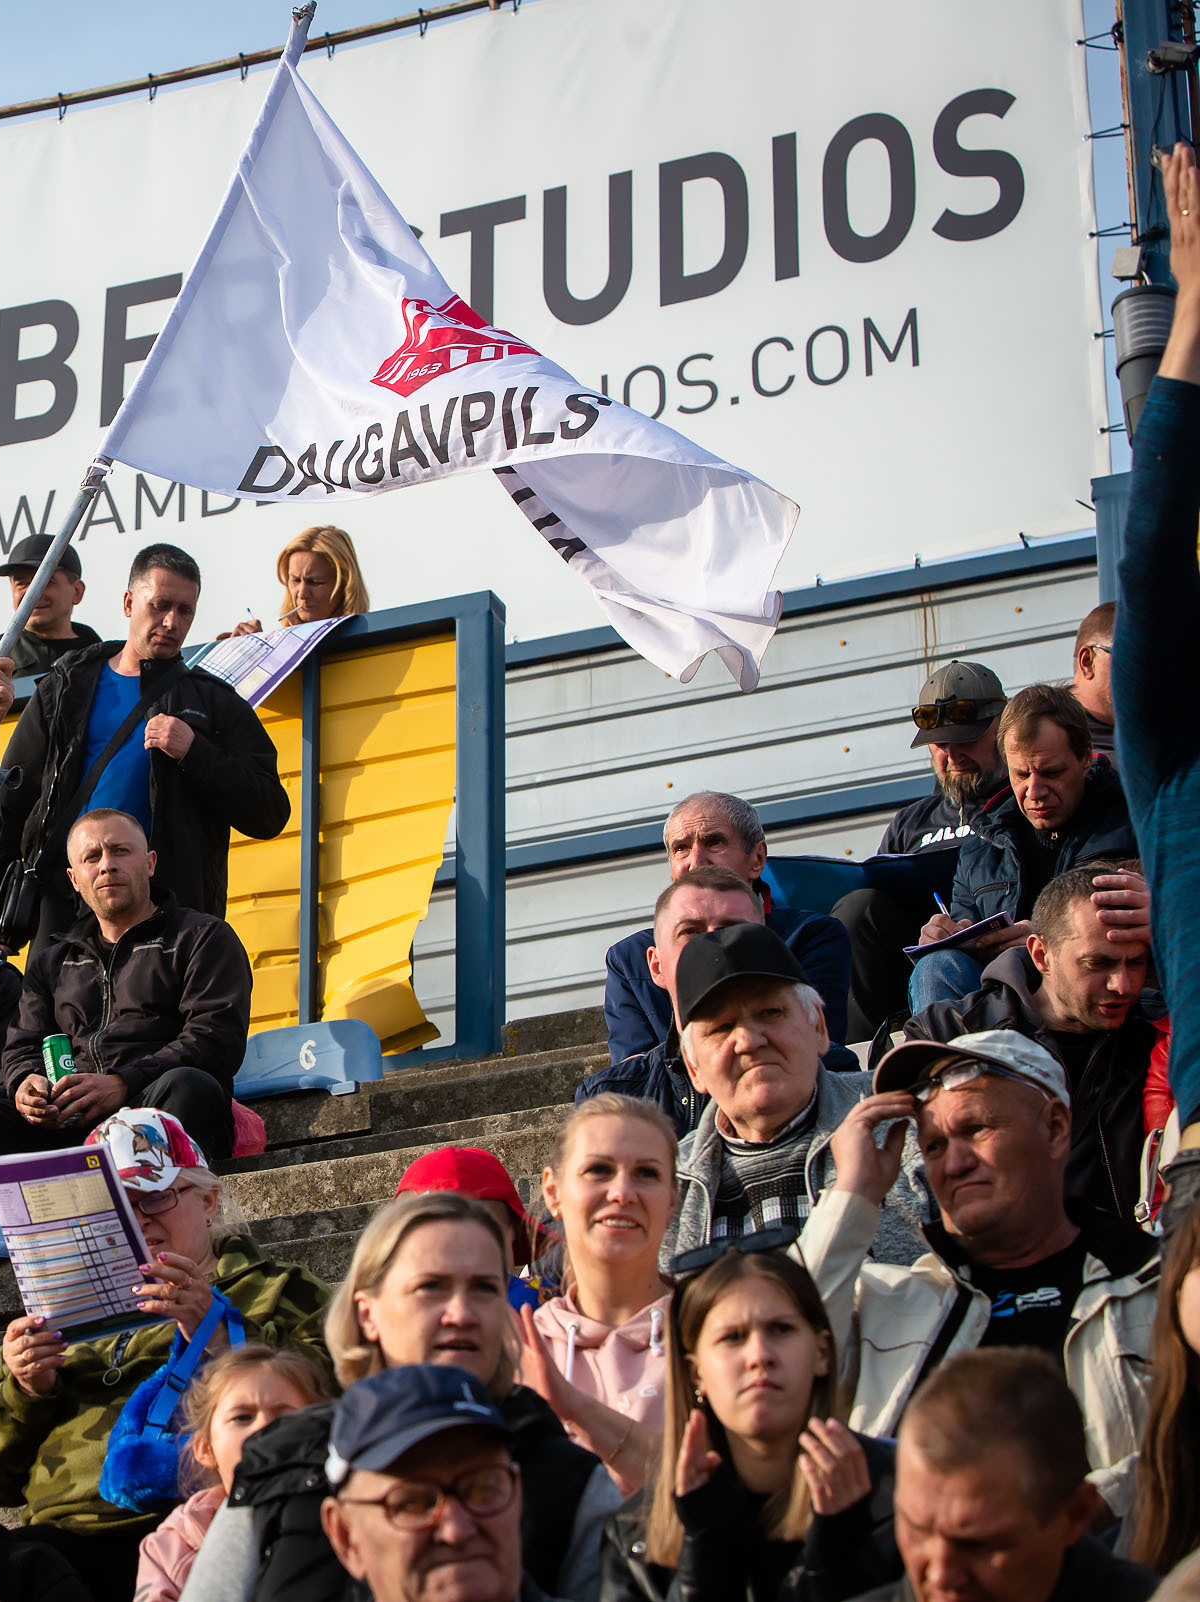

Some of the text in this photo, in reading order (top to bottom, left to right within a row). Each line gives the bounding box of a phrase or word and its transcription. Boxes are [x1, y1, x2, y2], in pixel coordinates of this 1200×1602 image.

[408, 88, 1026, 327] TUDIOS
[403, 362, 443, 383] 1963
[236, 386, 612, 496] DAUGAVPILS
[299, 1039, 317, 1071] 6
